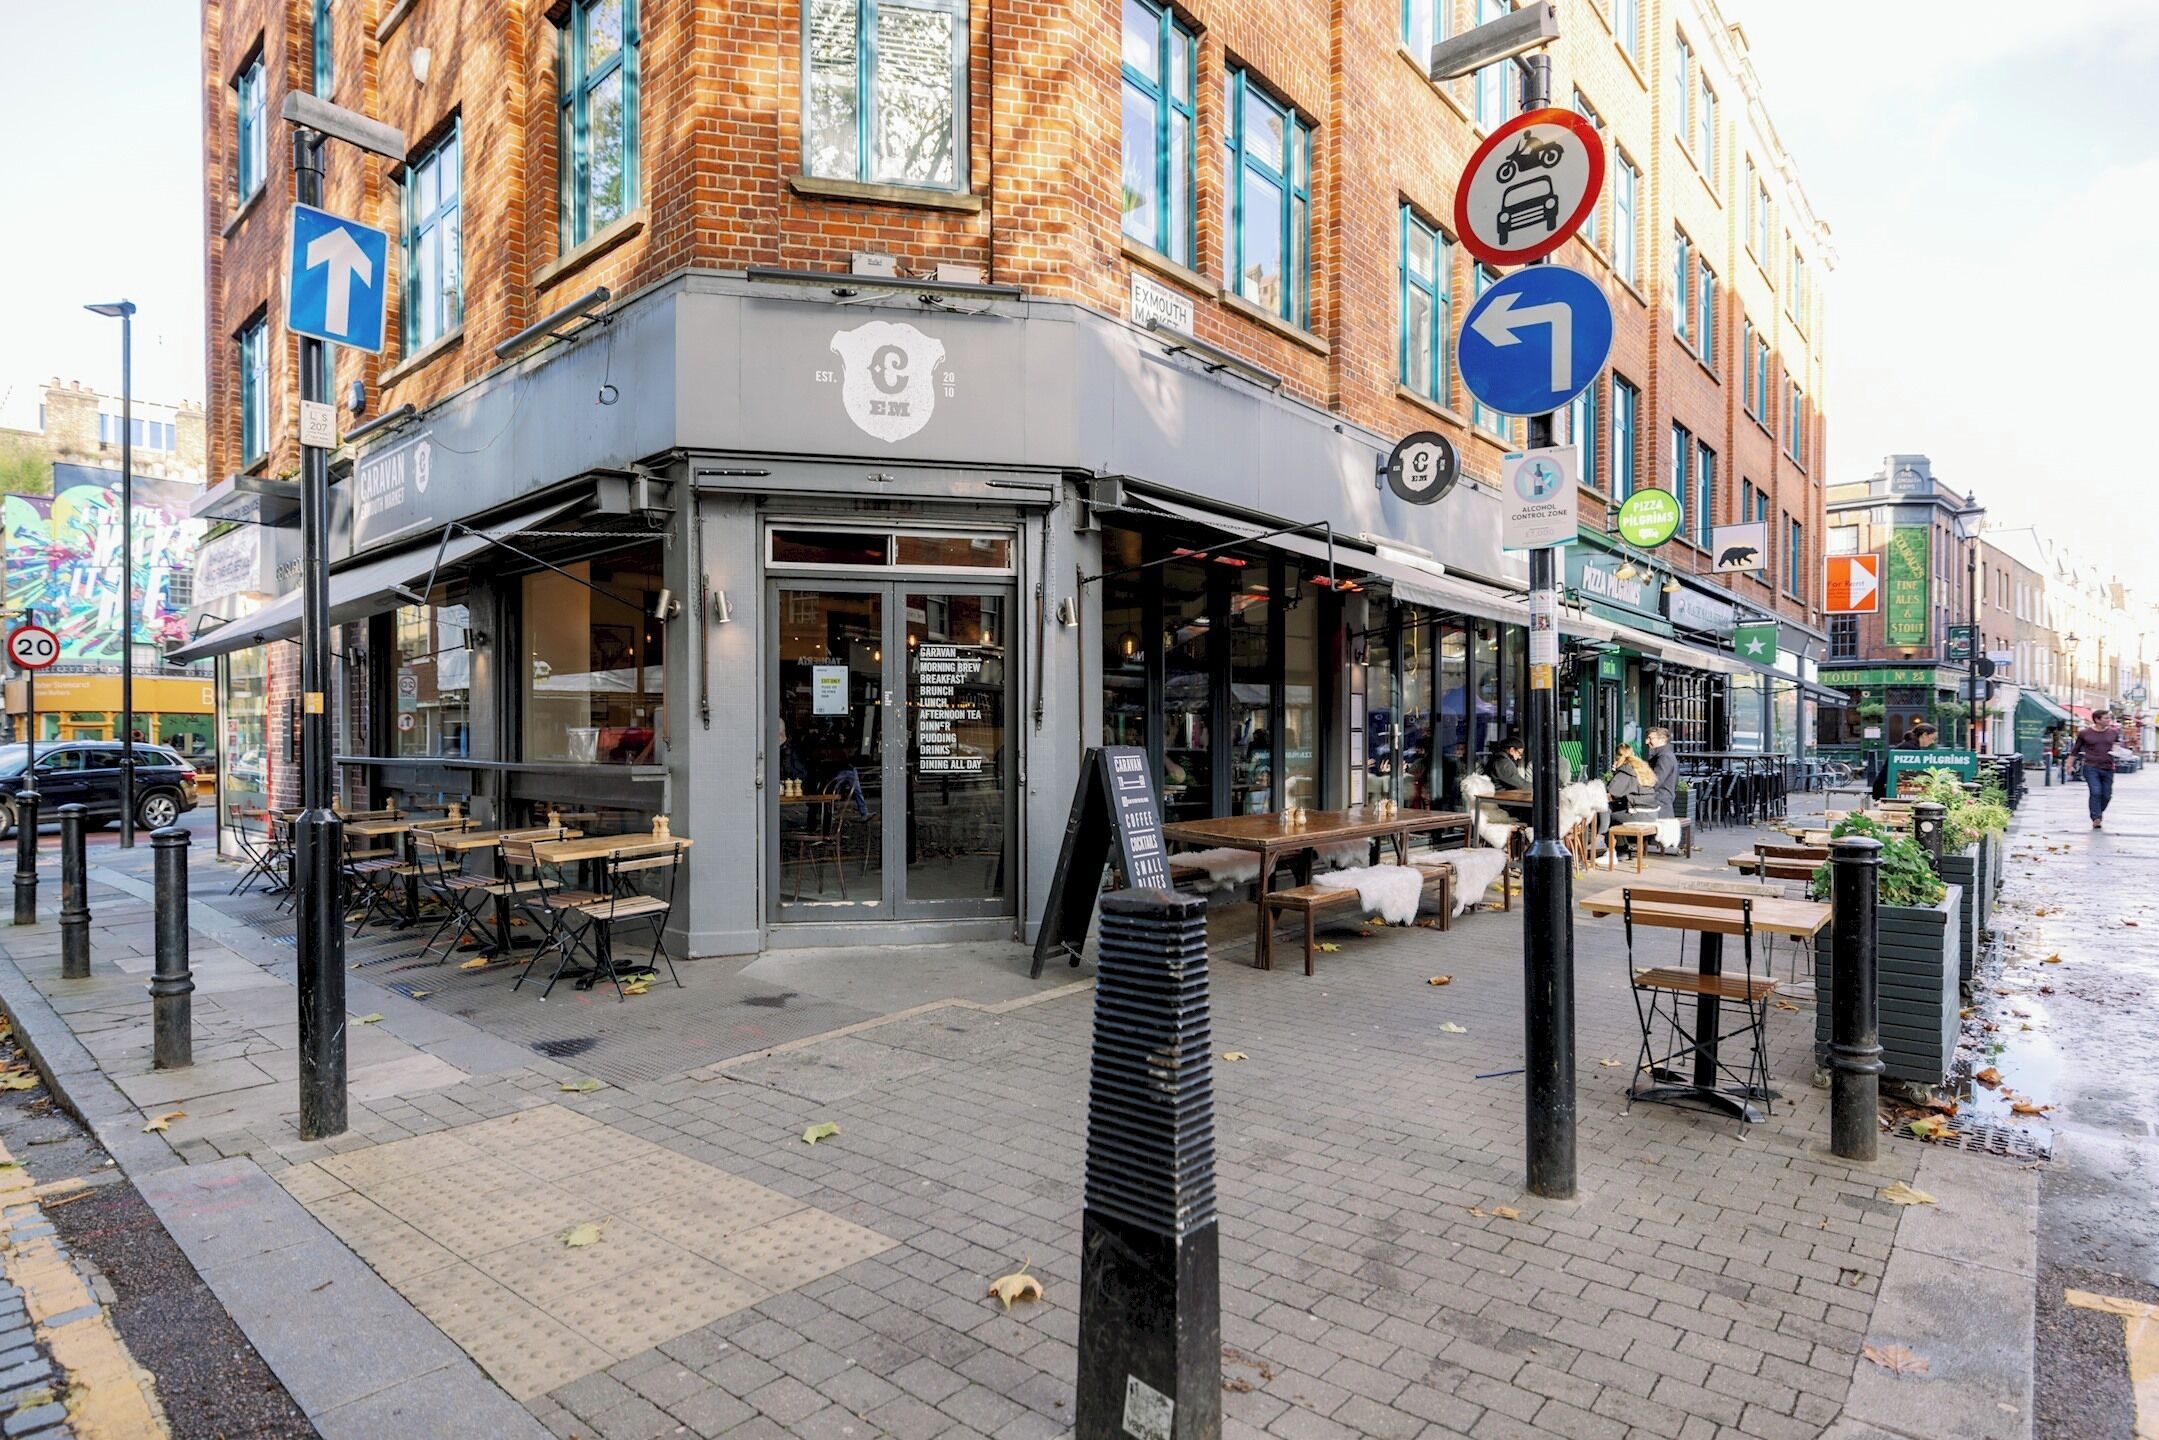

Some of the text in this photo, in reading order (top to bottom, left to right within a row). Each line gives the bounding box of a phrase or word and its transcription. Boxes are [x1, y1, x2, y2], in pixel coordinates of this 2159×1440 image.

[1135, 285, 1187, 325] EXMOUTH
[867, 344, 910, 395] C
[815, 370, 837, 383] EST.
[943, 371, 956, 383] 20
[944, 387, 955, 398] 10
[869, 400, 911, 417] EM
[310, 421, 328, 432] 207
[1412, 451, 1429, 473] C
[361, 451, 405, 502] CARAVAN
[1522, 504, 1557, 513] ALCOHOL
[1633, 499, 1664, 513] PIZZA
[1511, 509, 1568, 521] CONTROL ZONE
[1896, 580, 1918, 591] FINE
[1895, 595, 1920, 605] ALES
[1903, 608, 1912, 618] &
[1891, 623, 1925, 633] STOUT
[17, 639, 54, 656] 20
[919, 647, 956, 658] CARAVAN
[919, 662, 956, 673] MORNING
[957, 662, 981, 673] BREW
[919, 674, 966, 685] BREAKFAST
[1818, 671, 1860, 683] TOUT
[919, 686, 955, 696] BRUNCH
[919, 698, 948, 708] LUNCH
[919, 709, 982, 720] AFTERNOON TEA
[919, 721, 951, 732] DINNER
[919, 733, 957, 744] PUDDING
[919, 745, 951, 756] DRINKS
[919, 759, 982, 770] DINING ALL DAY
[1893, 755, 1921, 764] PIZZA
[1113, 758, 1143, 773] CARAVAN
[1124, 811, 1154, 828] COFFEE
[1130, 834, 1158, 852] COCKTAILS
[1134, 857, 1164, 876] SMALL
